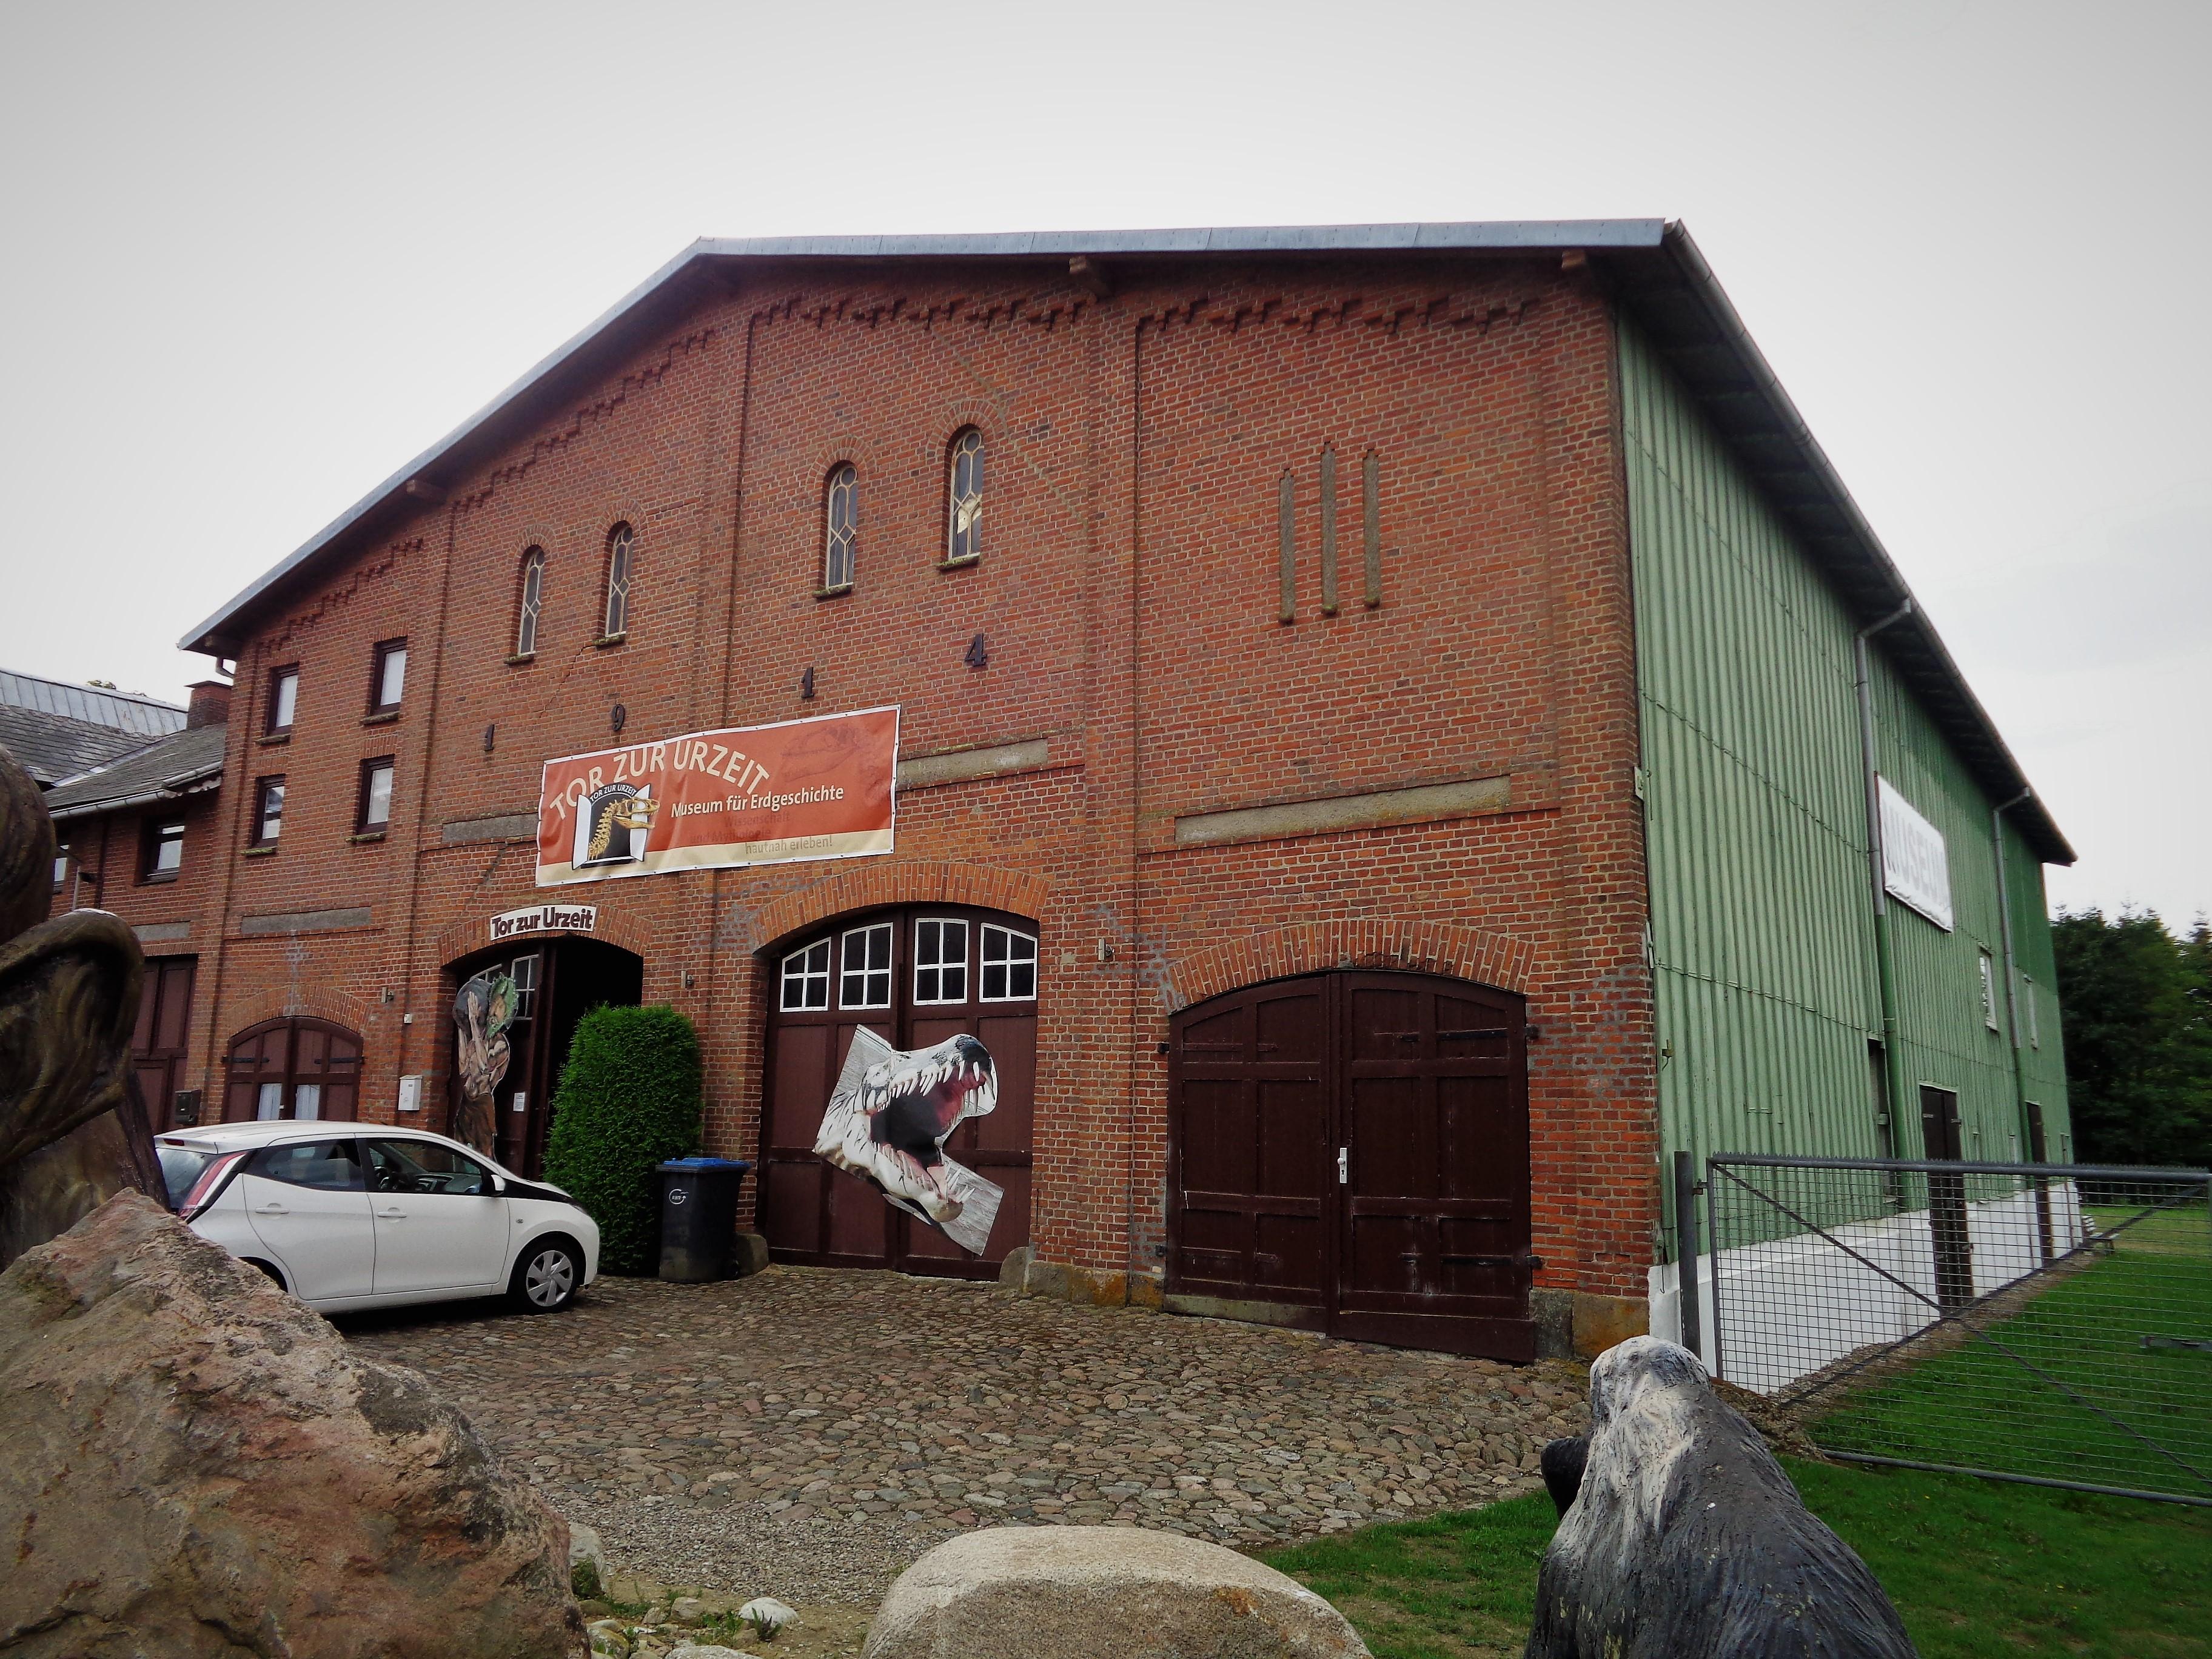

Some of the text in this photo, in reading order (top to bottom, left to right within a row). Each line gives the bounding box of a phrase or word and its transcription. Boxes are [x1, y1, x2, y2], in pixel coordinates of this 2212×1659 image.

[612, 703, 625, 731] 9
[801, 666, 814, 699] 1
[964, 633, 987, 667] 4
[549, 740, 770, 820] TOR ZUR URZEIT
[589, 784, 637, 802] TOR ZUR URZEIT
[671, 785, 844, 818] Museum für Erdgeschichte
[745, 835, 833, 854] hautnah erleben!
[492, 907, 593, 937] Tor zur Urzeit
